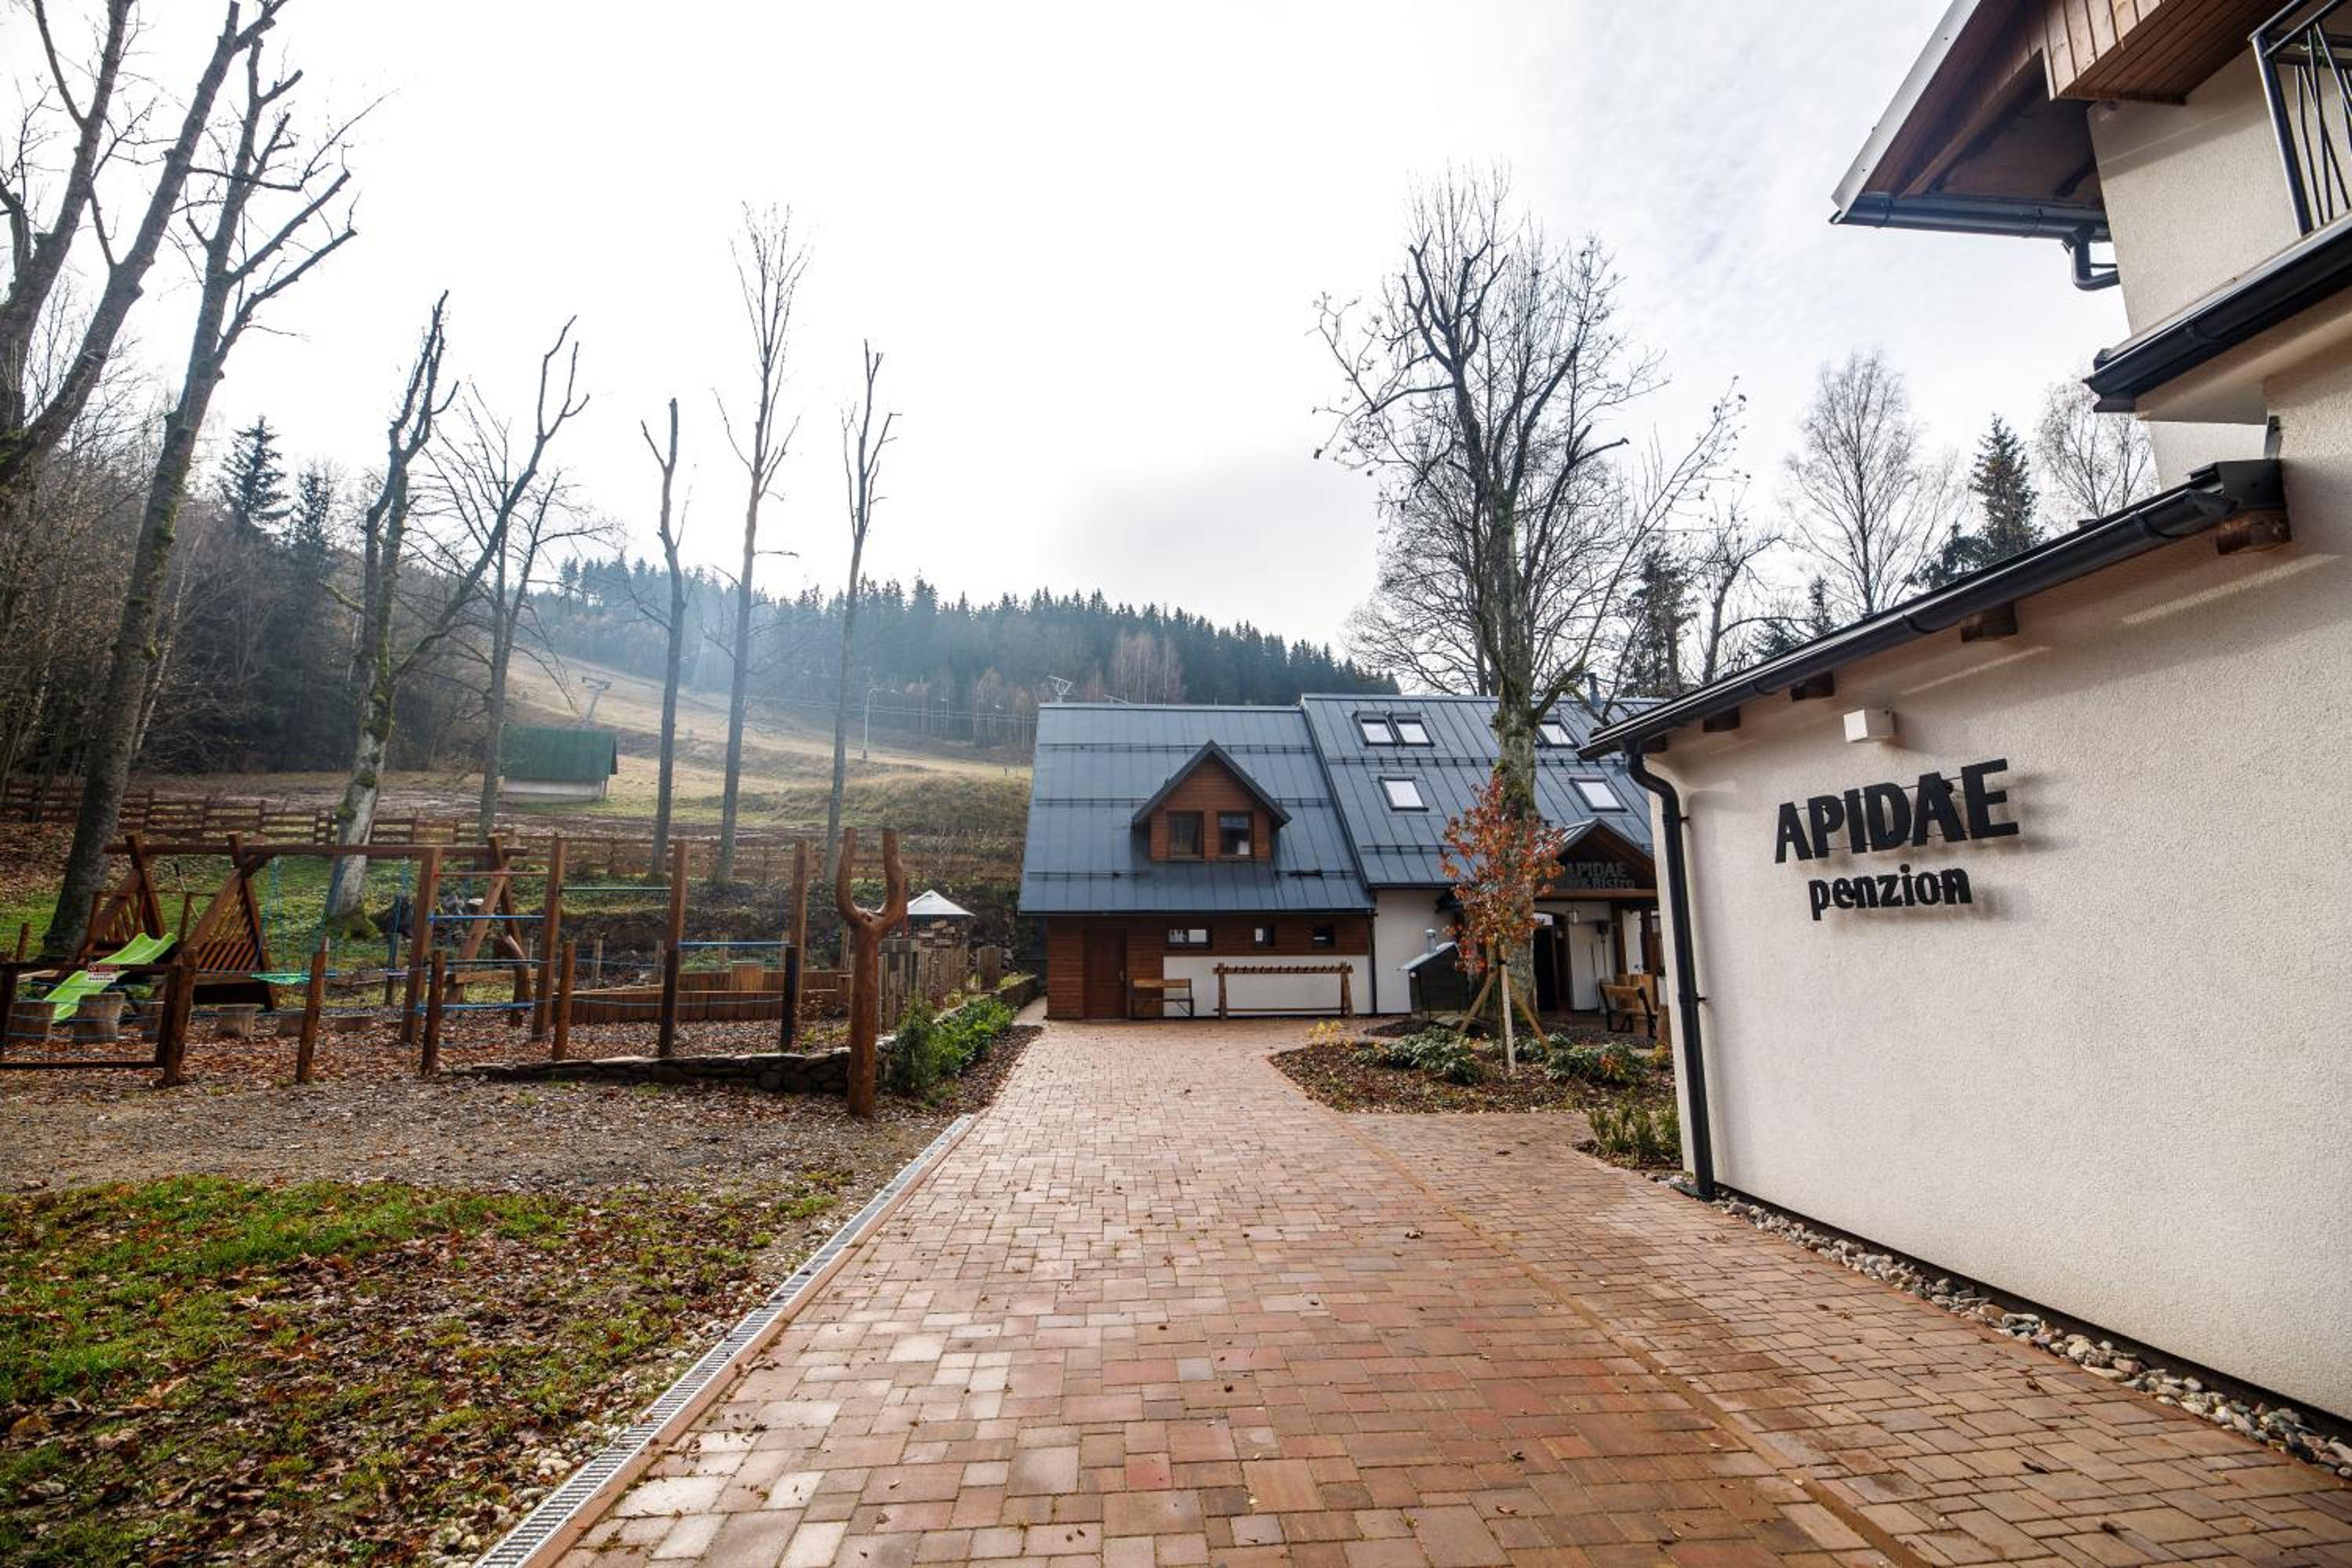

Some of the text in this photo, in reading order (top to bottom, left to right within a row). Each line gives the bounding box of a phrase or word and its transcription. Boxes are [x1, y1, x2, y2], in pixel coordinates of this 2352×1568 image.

[1775, 758, 2019, 863] APIDAE
[1566, 862, 1628, 878] APIDAE
[1808, 864, 1972, 920] penzion
